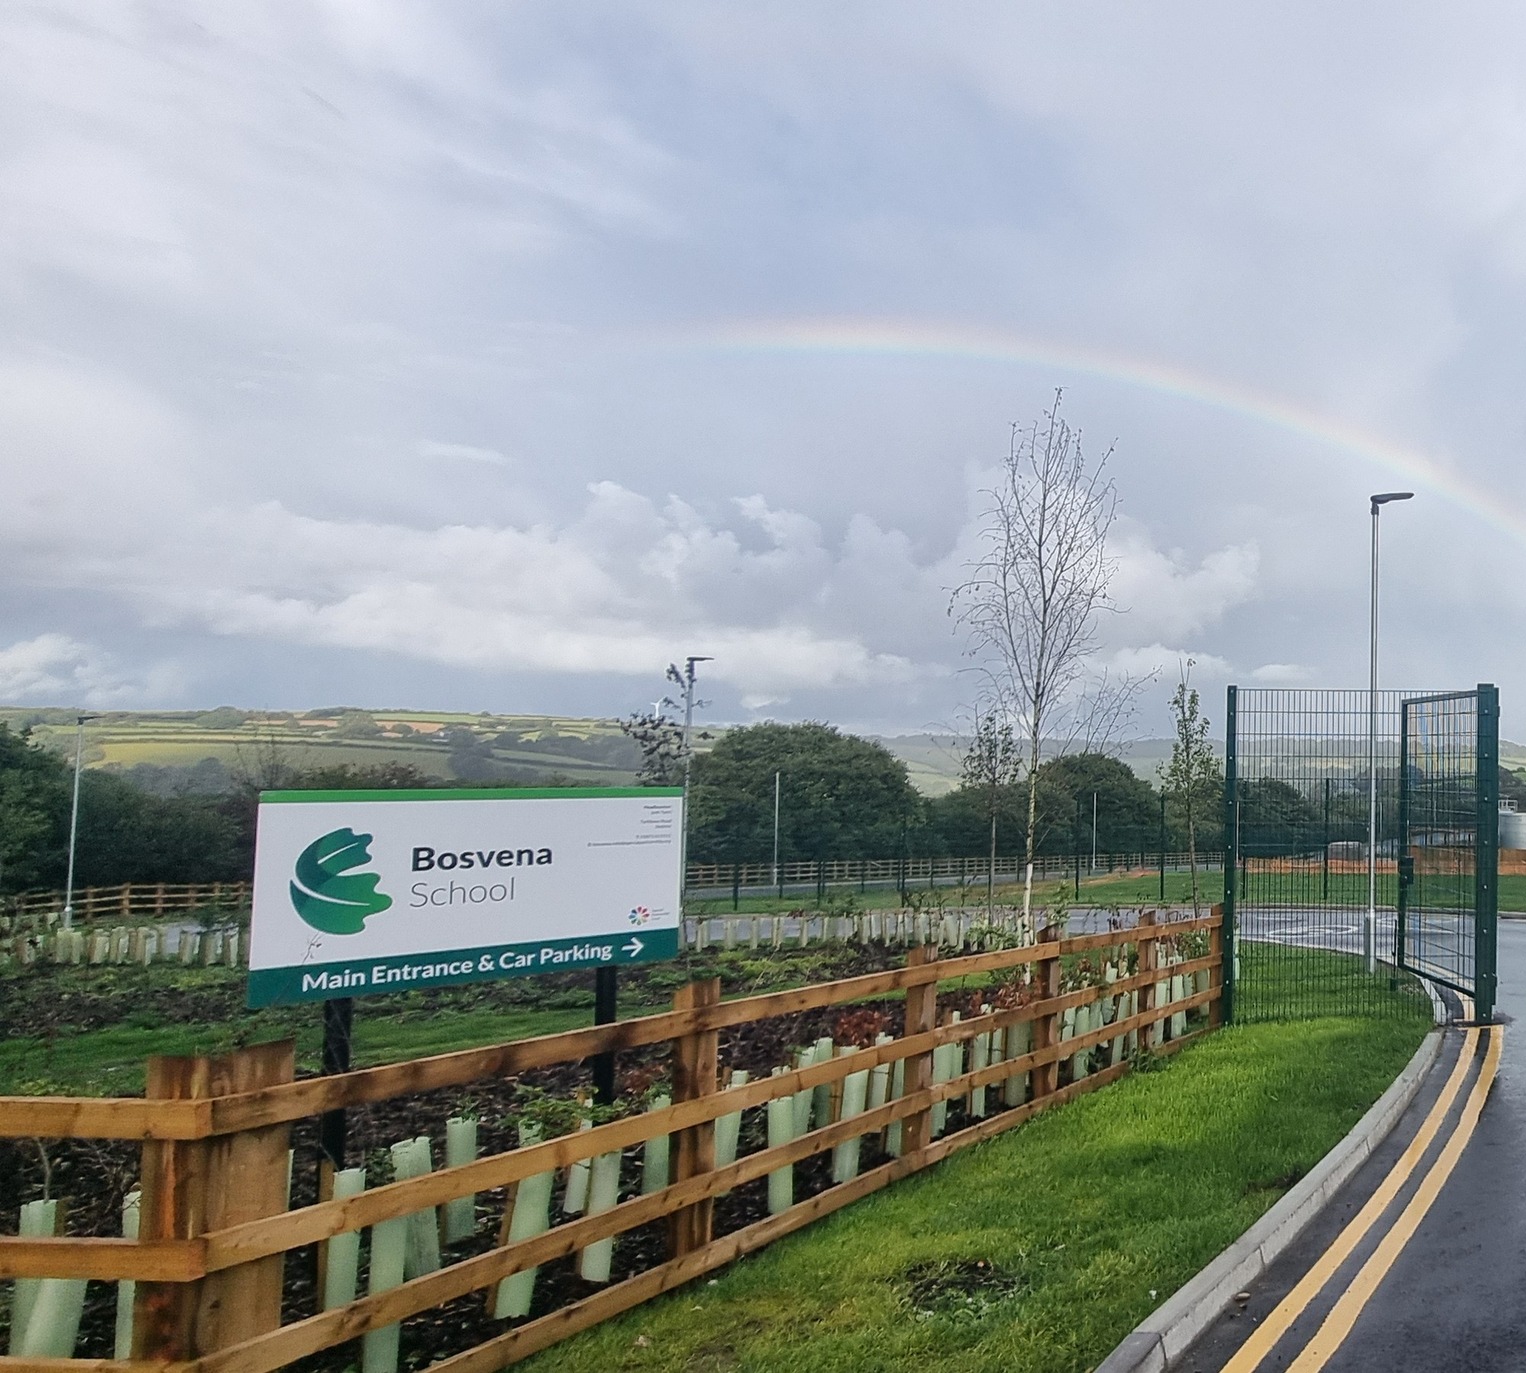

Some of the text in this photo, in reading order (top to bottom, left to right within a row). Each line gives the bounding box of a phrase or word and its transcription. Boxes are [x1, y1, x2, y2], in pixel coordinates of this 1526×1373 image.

[411, 846, 552, 872] Bosvena
[409, 876, 515, 908] School
[302, 943, 613, 992] Main Entrance & Car Parking
